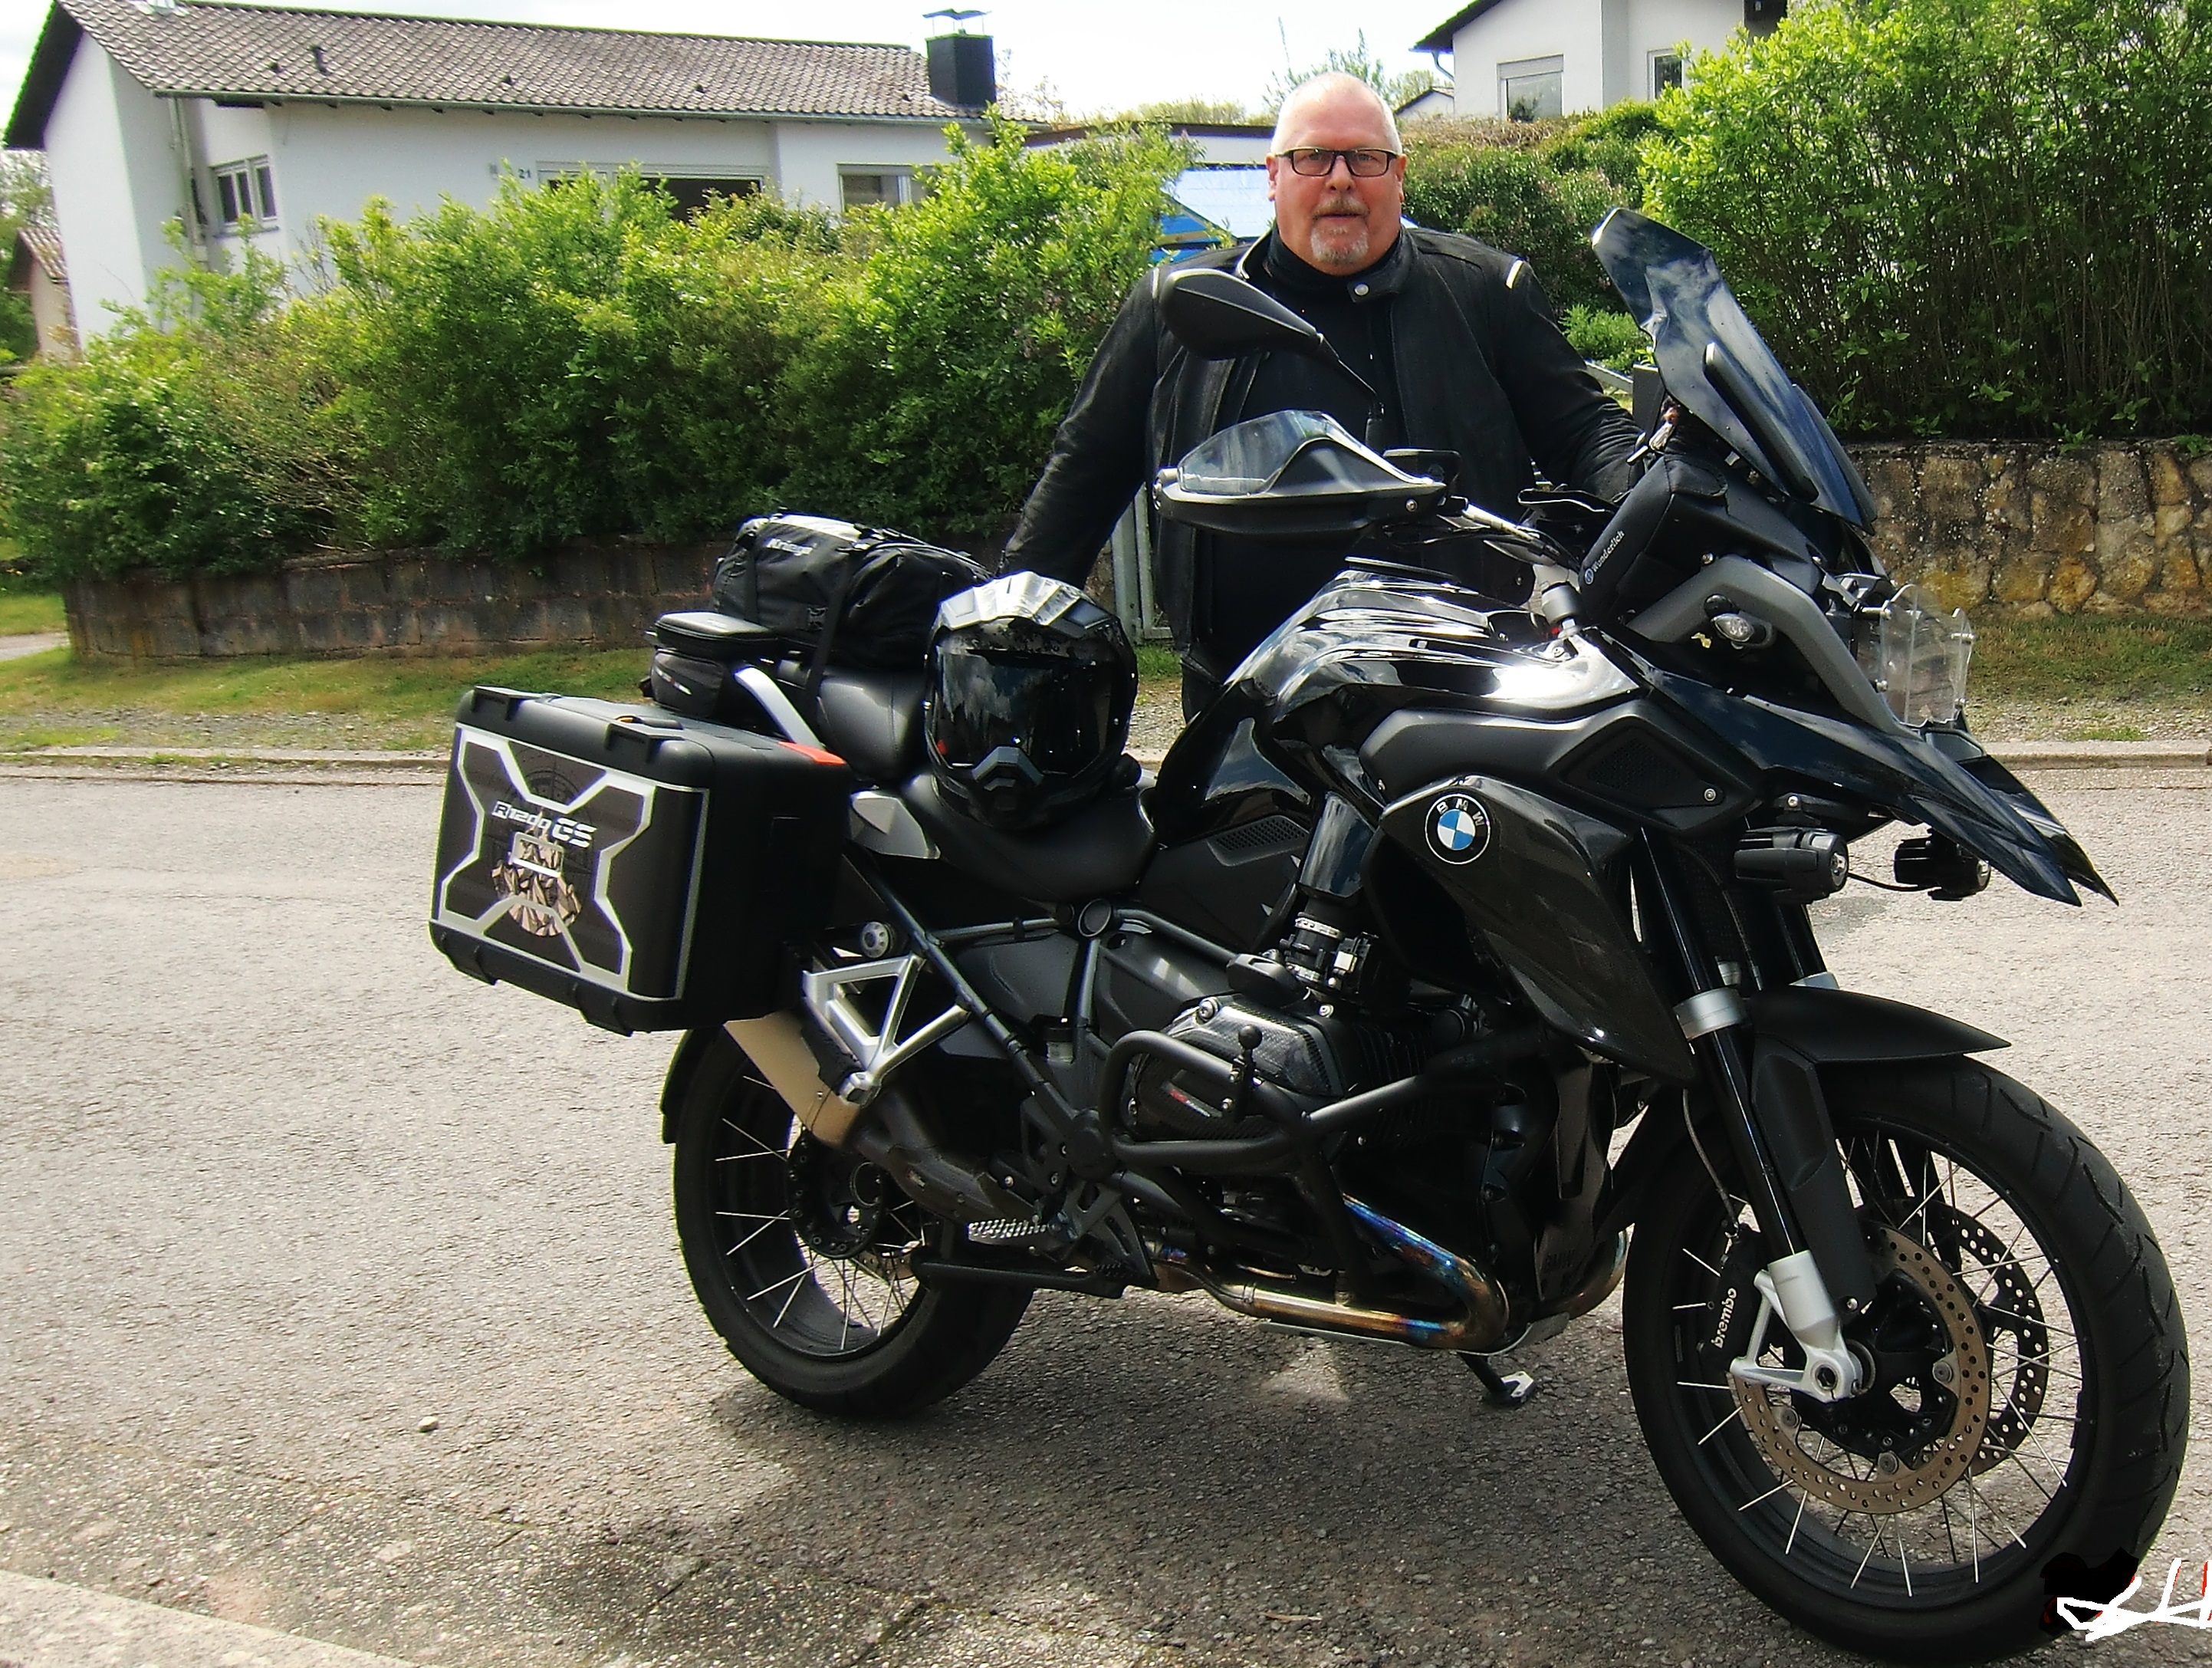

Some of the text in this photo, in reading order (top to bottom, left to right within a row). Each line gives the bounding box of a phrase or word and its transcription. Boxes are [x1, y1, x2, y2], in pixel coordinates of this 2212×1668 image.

[518, 168, 531, 179] 21
[1591, 530, 1625, 572] Wunderlich
[491, 800, 597, 847] R1200 GS
[1436, 798, 1485, 826] BMW
[1711, 1288, 1737, 1348] brembo
